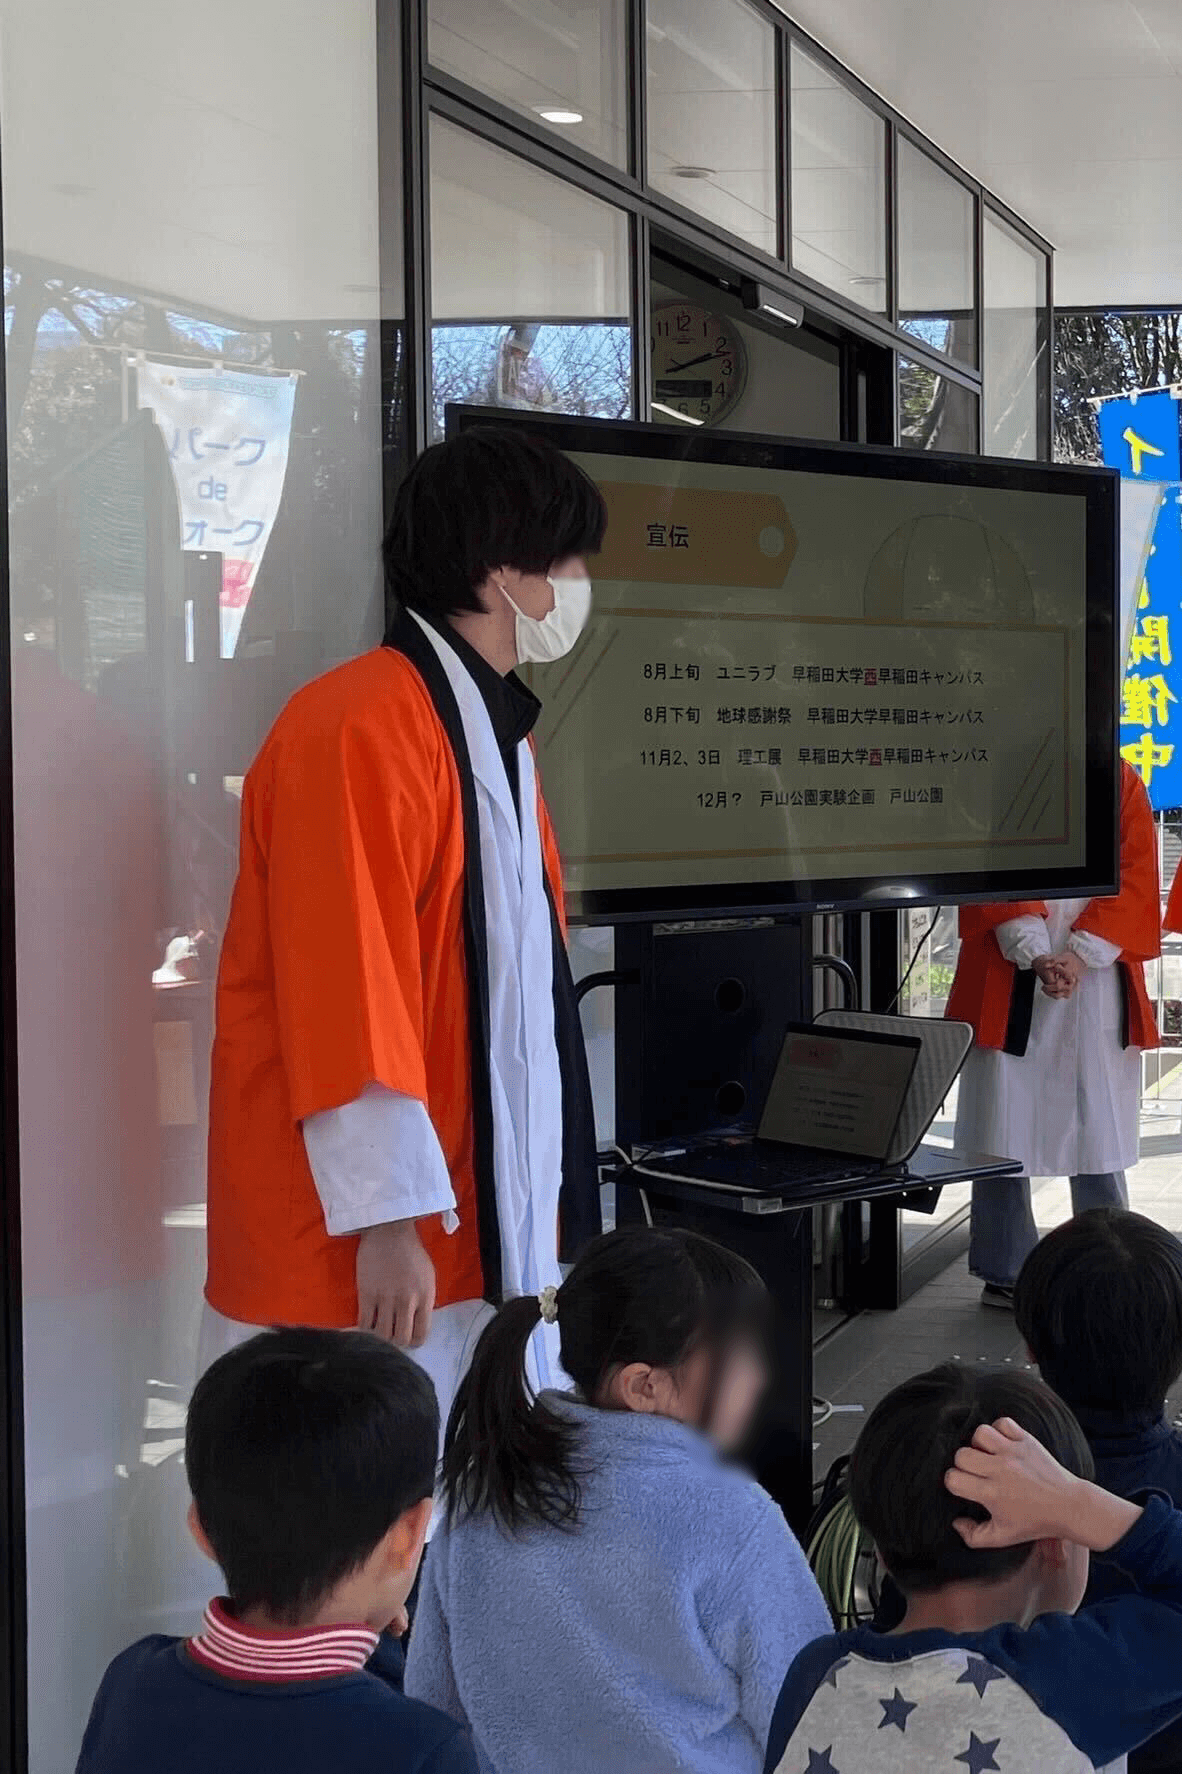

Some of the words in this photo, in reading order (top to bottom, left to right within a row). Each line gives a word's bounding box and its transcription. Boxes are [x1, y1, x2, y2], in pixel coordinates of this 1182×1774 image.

[657, 321, 669, 336] 11
[677, 313, 691, 331] 12
[722, 359, 732, 375] 3
[714, 382, 725, 398] 4
[198, 476, 228, 500] de
[646, 522, 689, 548] 宣伝
[644, 663, 700, 682] 8月上旬
[792, 665, 985, 687] 早稲田大学西早稲田キャンパス
[644, 706, 700, 725] 8月下旬
[716, 706, 793, 725] 地球感謝祭
[806, 706, 985, 726] 早稲田大学早稲田キャンパス
[738, 748, 782, 767] 理工展
[797, 748, 990, 767] 早稲田大学西早稲田キャンパス
[759, 788, 875, 807] 戸山公園実験企画
[890, 786, 944, 804] 戸山公園
